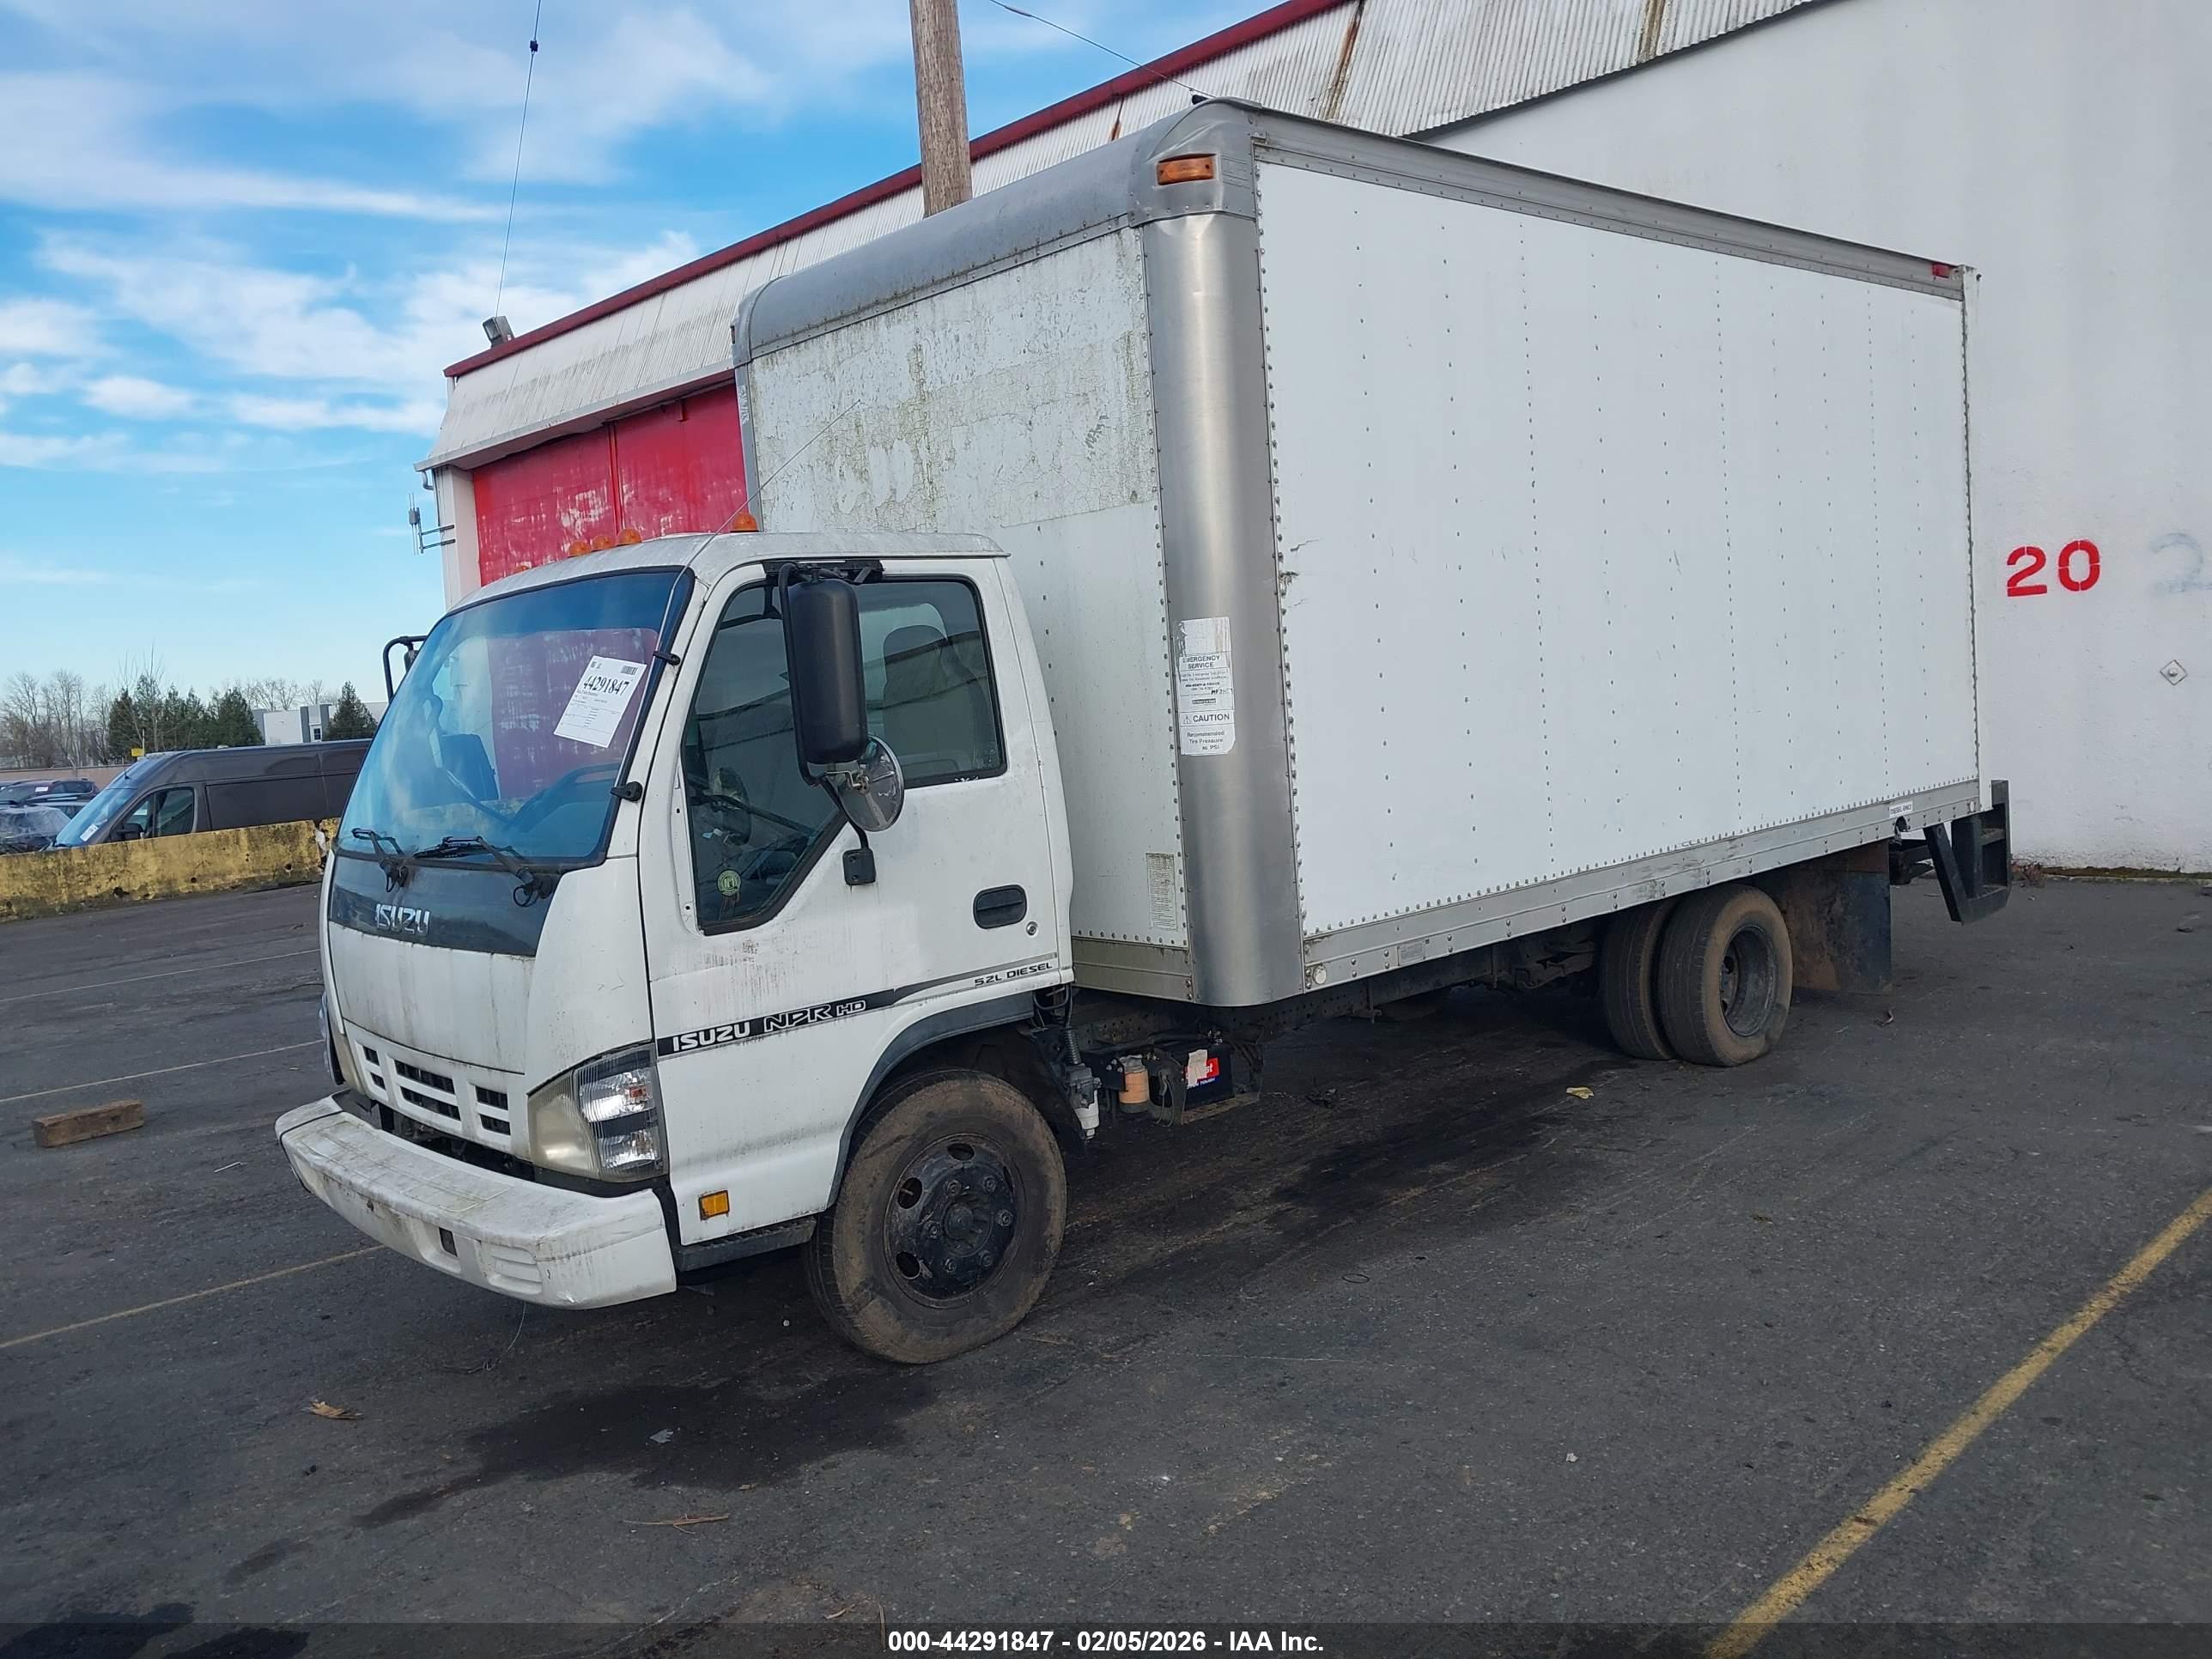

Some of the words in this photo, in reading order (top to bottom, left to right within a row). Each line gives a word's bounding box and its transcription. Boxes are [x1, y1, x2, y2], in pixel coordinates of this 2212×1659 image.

[2006, 538, 2101, 597] 20
[584, 676, 629, 696] 44291847
[1193, 714, 1230, 722] CAUTION
[374, 903, 430, 938] ISUZU
[1006, 962, 1053, 979] DIESEL
[672, 1021, 750, 1052] ISUZU
[763, 1004, 834, 1033] NPR
[836, 1000, 866, 1016] HD
